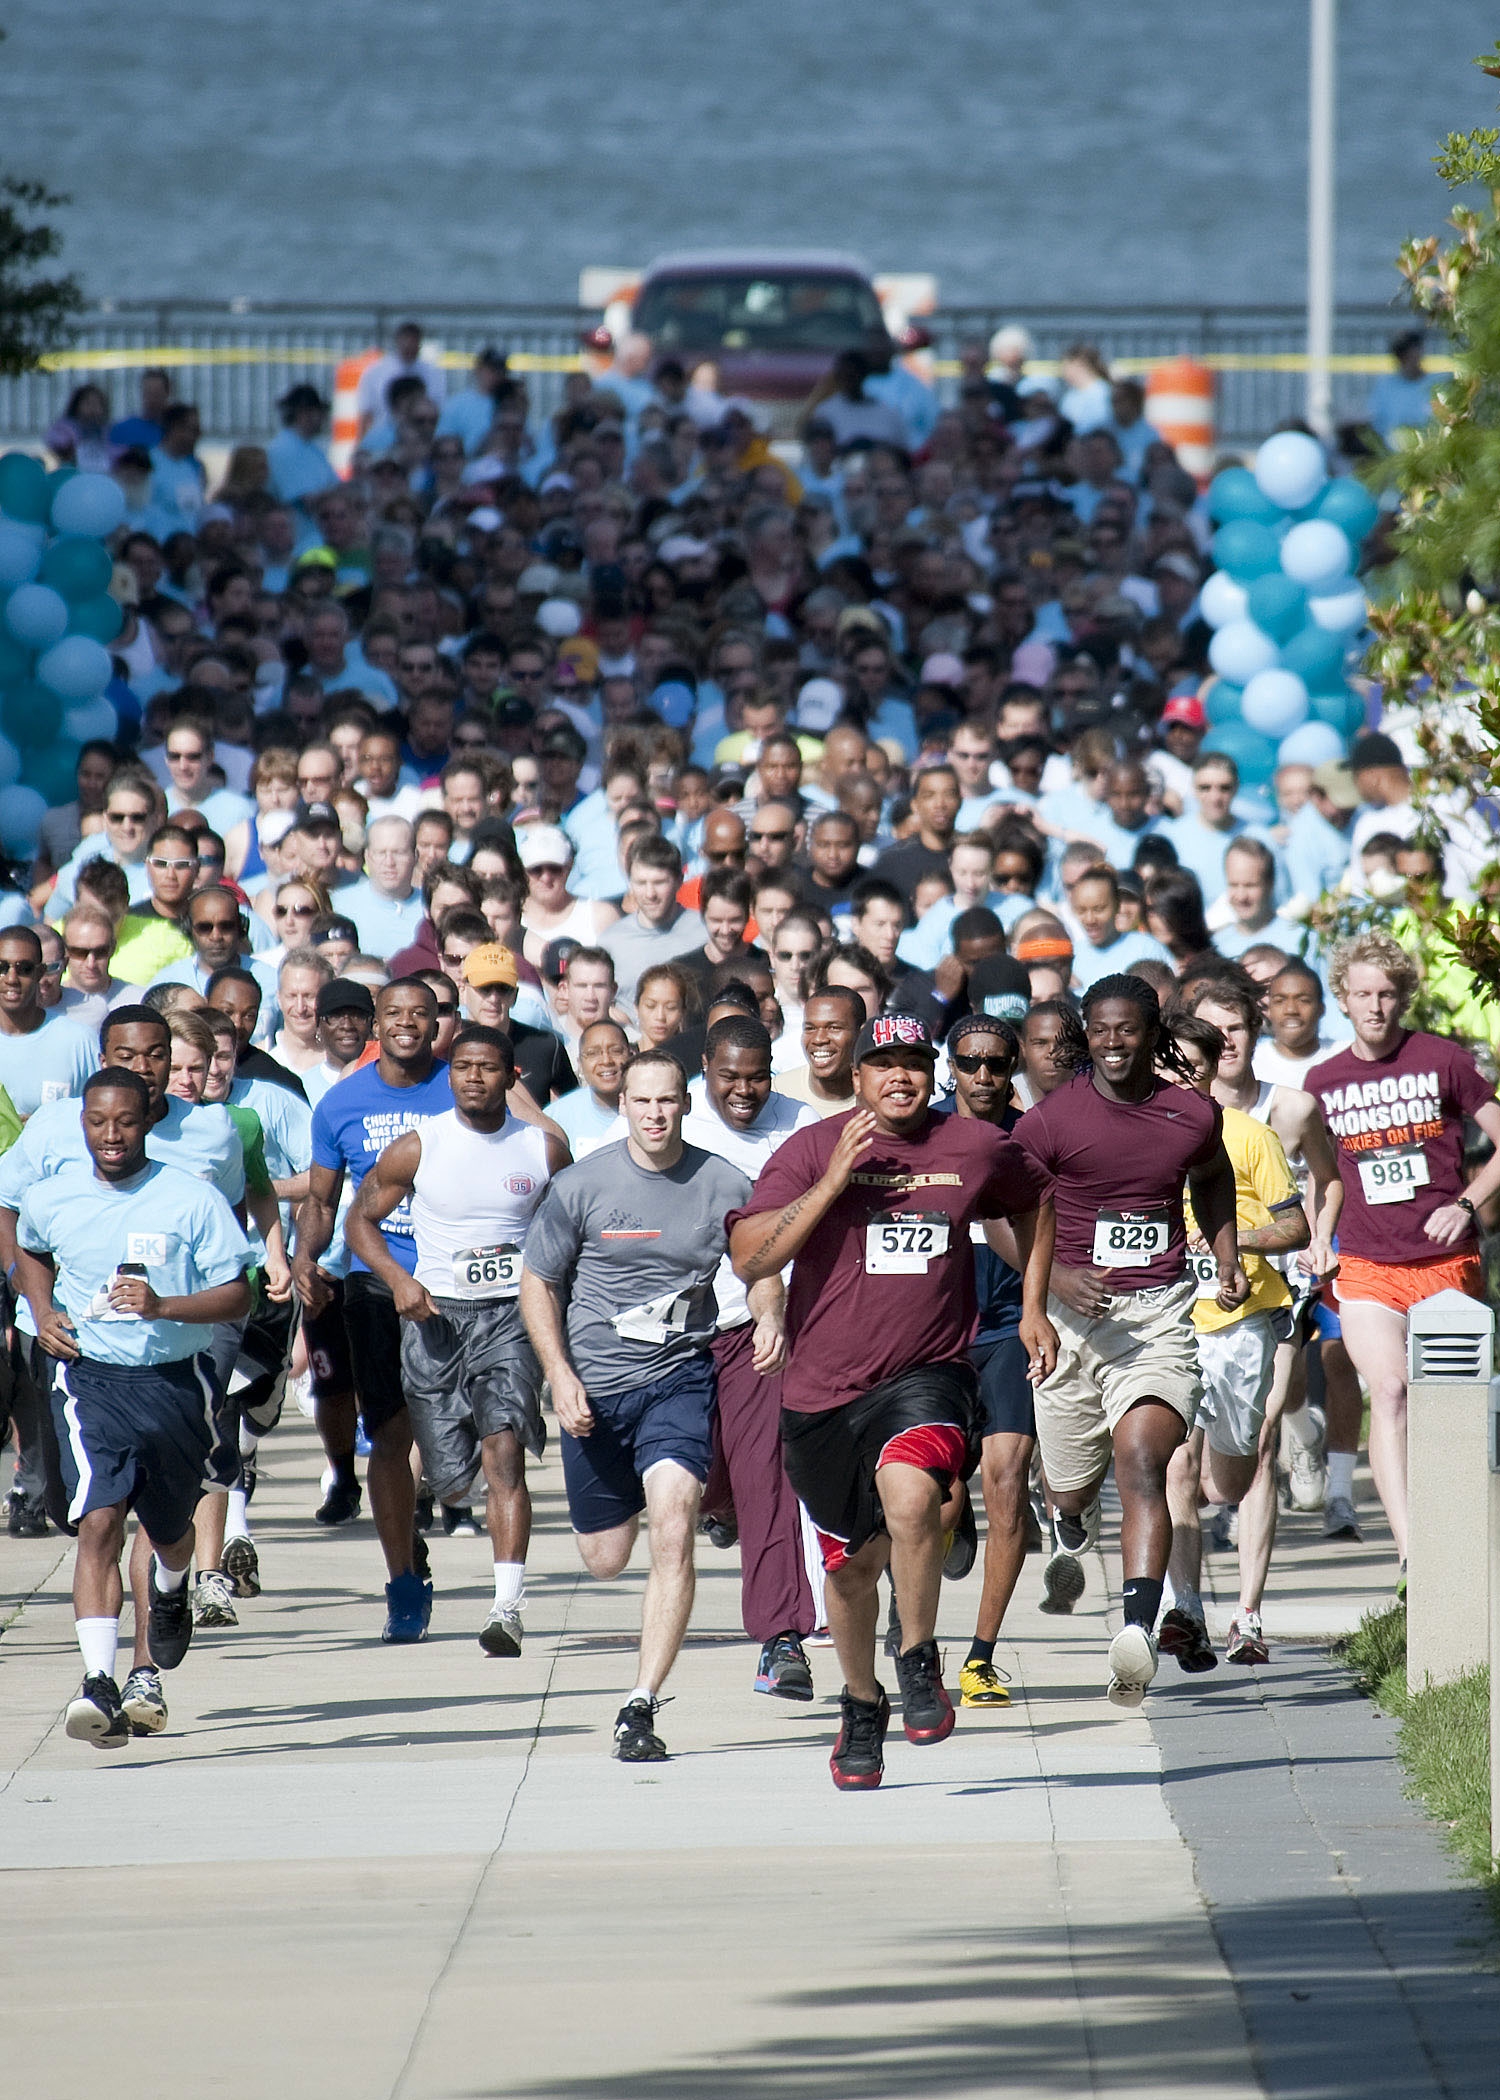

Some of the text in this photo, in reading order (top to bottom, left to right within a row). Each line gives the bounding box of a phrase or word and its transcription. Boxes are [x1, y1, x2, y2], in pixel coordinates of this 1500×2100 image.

[1321, 1071, 1439, 1115] MAROON
[362, 1113, 401, 1130] CHUCK
[1328, 1098, 1442, 1137] MONSOON
[368, 1126, 391, 1138] WAS
[1386, 1127, 1410, 1145] ON
[1413, 1120, 1444, 1142] FIRE
[1371, 1158, 1416, 1186] 981
[514, 1182, 527, 1192] 36
[133, 1240, 161, 1258] 5K
[882, 1227, 933, 1253] 572
[1109, 1226, 1159, 1250] 829
[466, 1257, 513, 1284] 665
